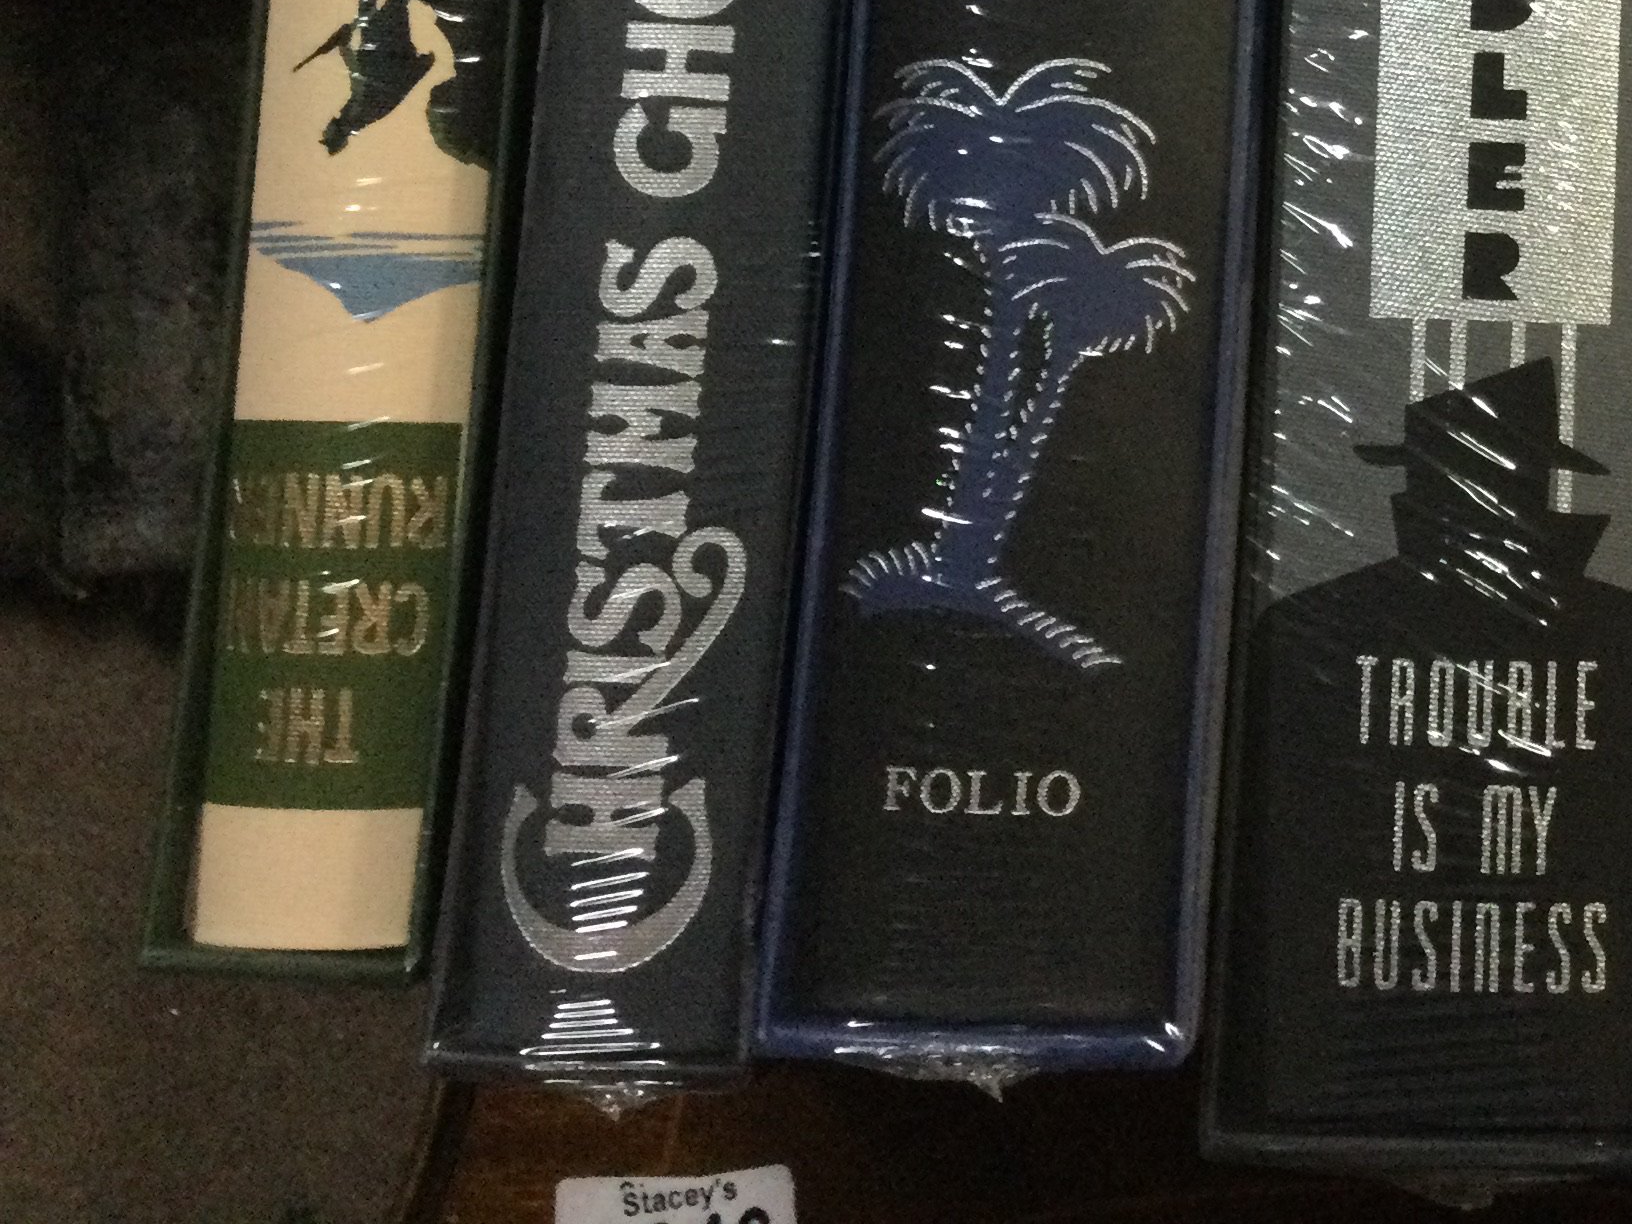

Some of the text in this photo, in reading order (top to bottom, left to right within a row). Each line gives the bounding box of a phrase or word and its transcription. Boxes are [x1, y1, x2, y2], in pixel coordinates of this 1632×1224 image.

[226, 578, 430, 658] CRETAN
[500, 233, 747, 975] CHRISTMAS
[254, 687, 360, 765] THE
[1356, 654, 1598, 750] TROUBLE
[883, 765, 1081, 816] FOLIO
[1393, 781, 1557, 875] IS MY
[1337, 898, 1607, 994] BUSINESS
[622, 1178, 738, 1217] Stacey's
